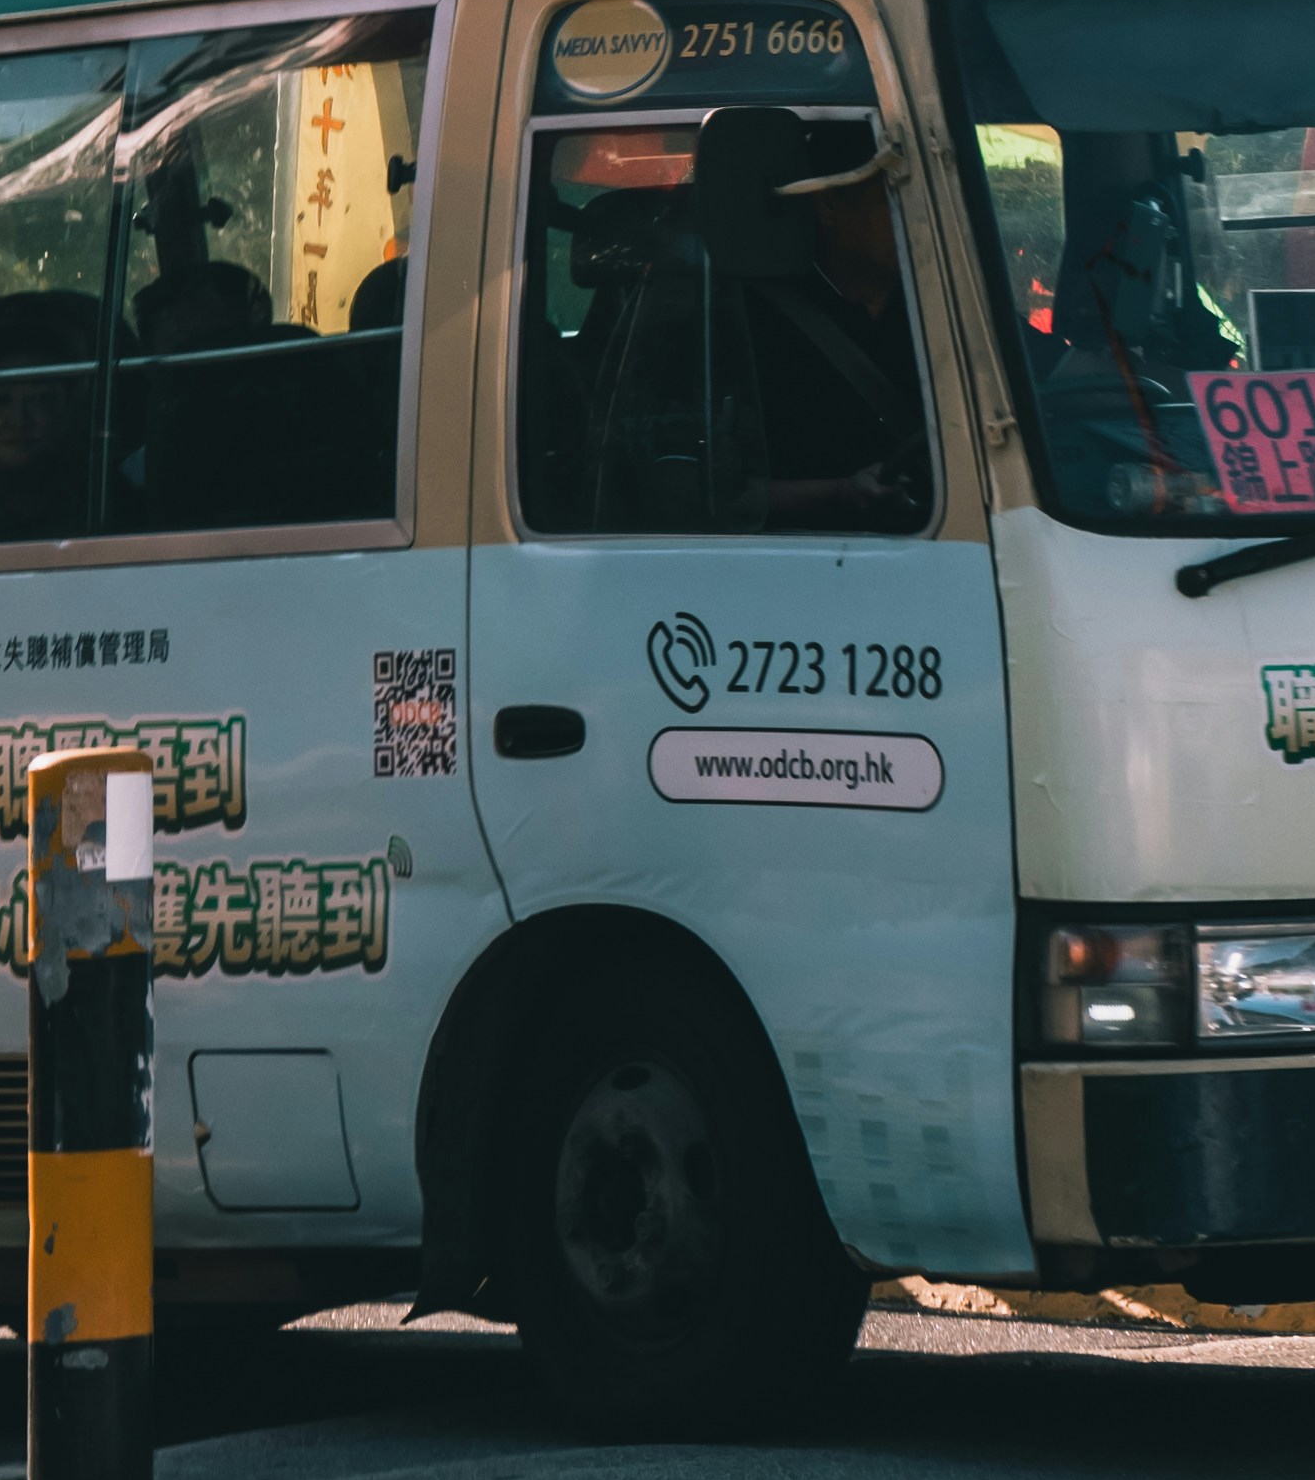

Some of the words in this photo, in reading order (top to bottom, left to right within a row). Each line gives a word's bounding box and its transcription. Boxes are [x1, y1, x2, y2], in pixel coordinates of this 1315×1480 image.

[554, 36, 606, 58] MEDIA
[610, 32, 664, 53] SAVVY
[680, 22, 754, 58] 2751
[767, 19, 844, 54] 6666
[727, 640, 825, 694] 2723
[842, 643, 942, 699] 1288
[390, 701, 441, 726] ODCB
[695, 749, 894, 790] www.odcb.org.hk
